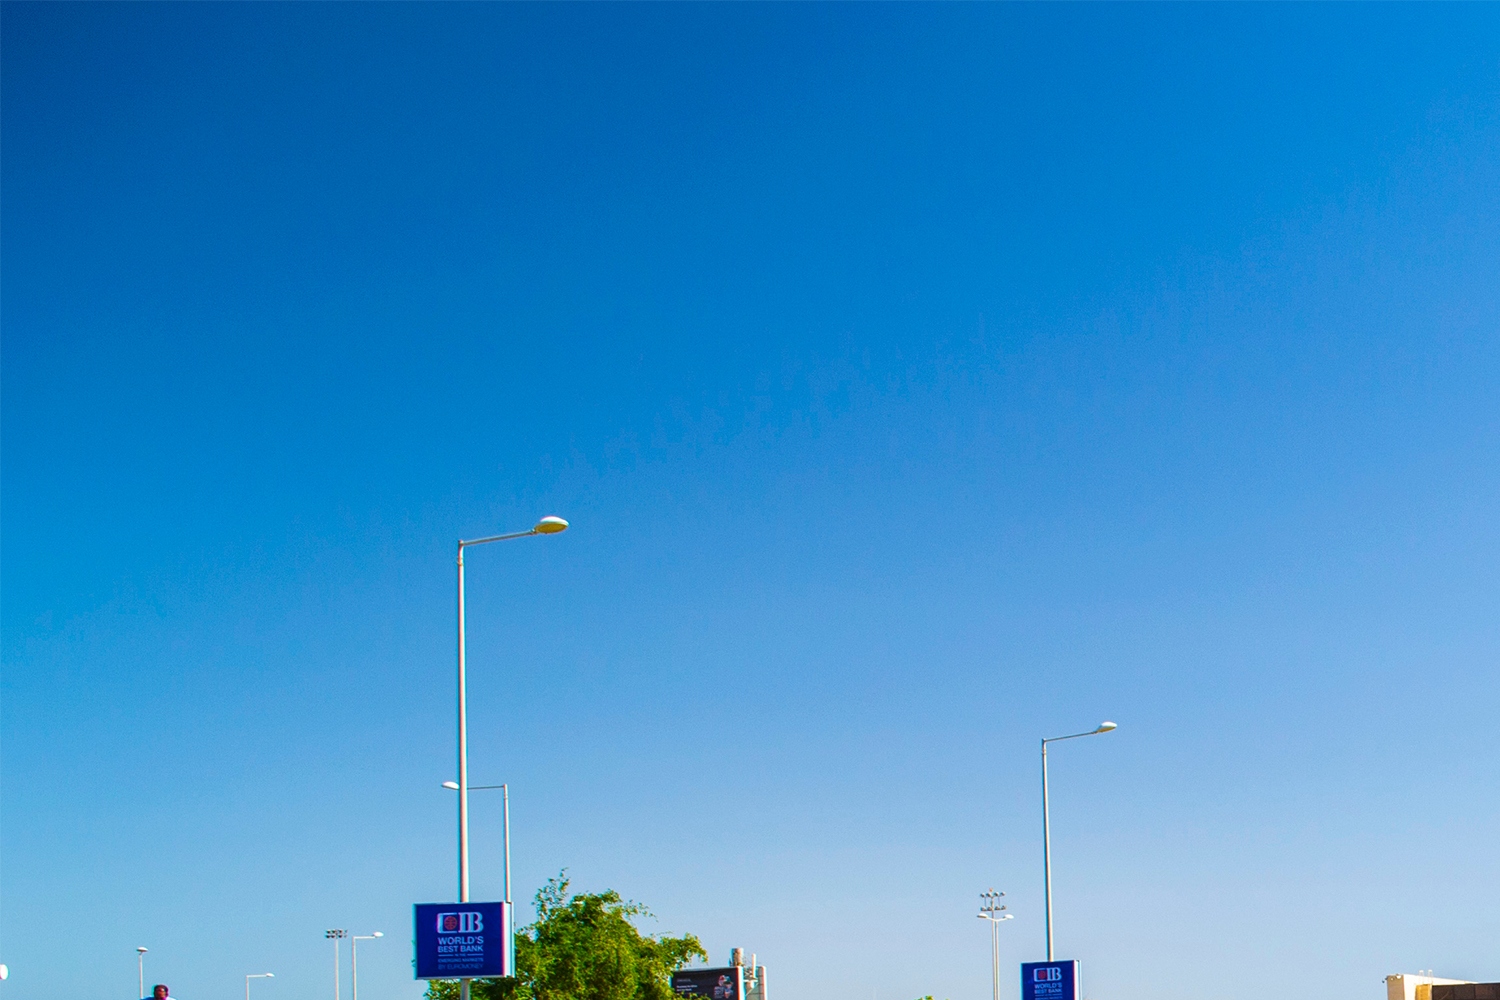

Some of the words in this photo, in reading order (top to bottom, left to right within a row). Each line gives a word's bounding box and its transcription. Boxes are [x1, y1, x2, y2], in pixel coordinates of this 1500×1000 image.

[437, 936, 484, 946] WORLD'S
[437, 945, 459, 953] BEST
[460, 945, 484, 953] BANK
